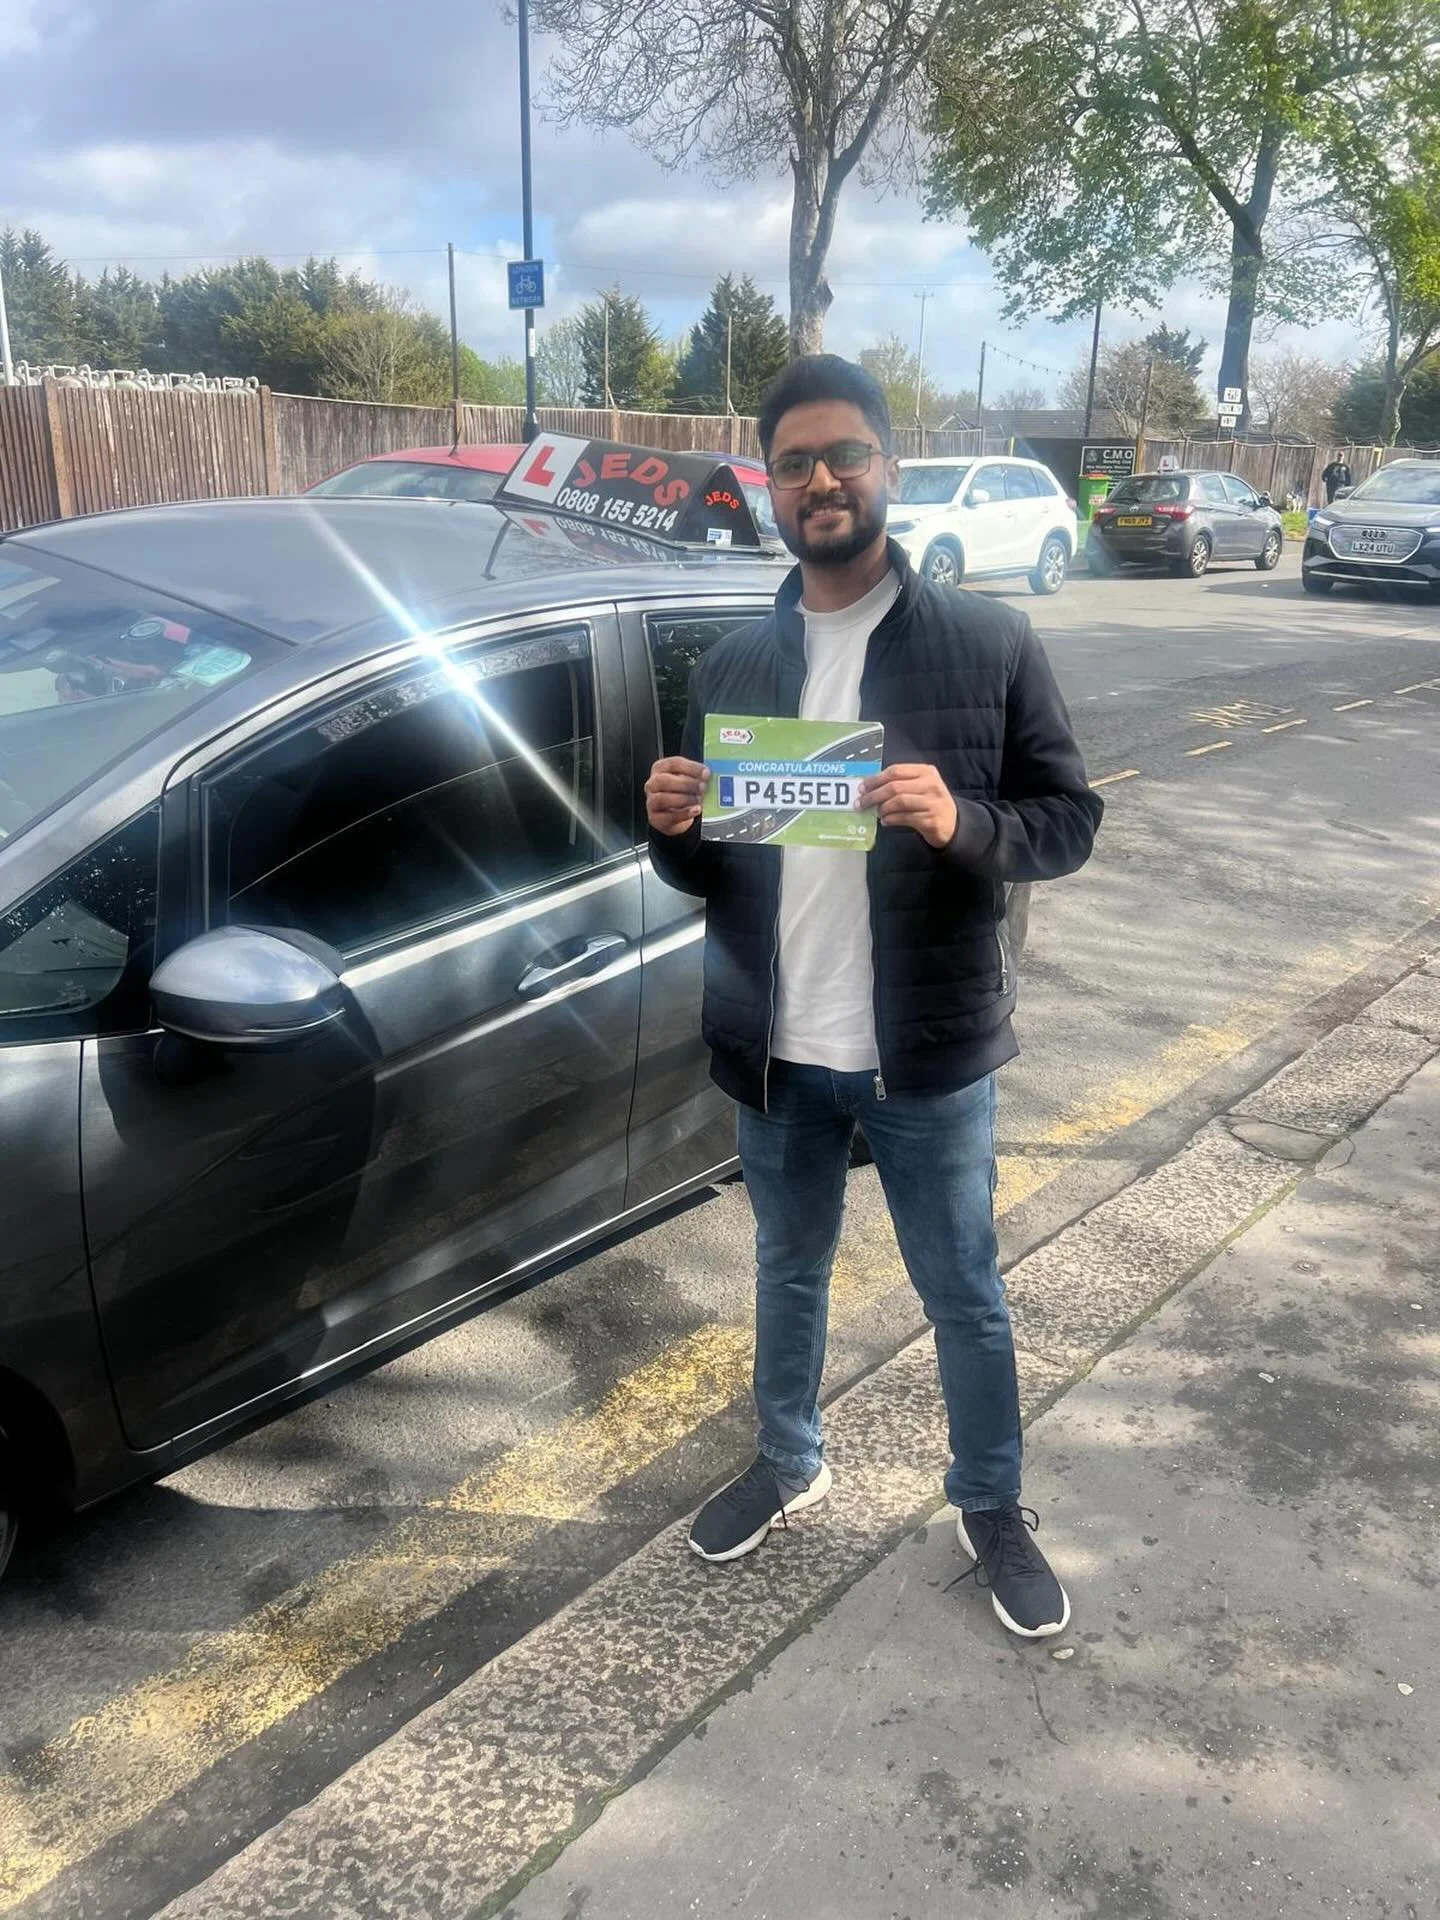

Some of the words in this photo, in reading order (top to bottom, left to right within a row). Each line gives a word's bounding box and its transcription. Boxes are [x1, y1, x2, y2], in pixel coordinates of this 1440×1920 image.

[523, 446, 556, 487] L
[573, 453, 690, 506] JEDS
[557, 487, 600, 515] 0808
[601, 497, 635, 522] 155
[632, 503, 679, 532] 5214
[705, 490, 740, 509] JEDS
[738, 761, 846, 774] CONGRATULATIONS
[745, 780, 850, 806] P455ED
